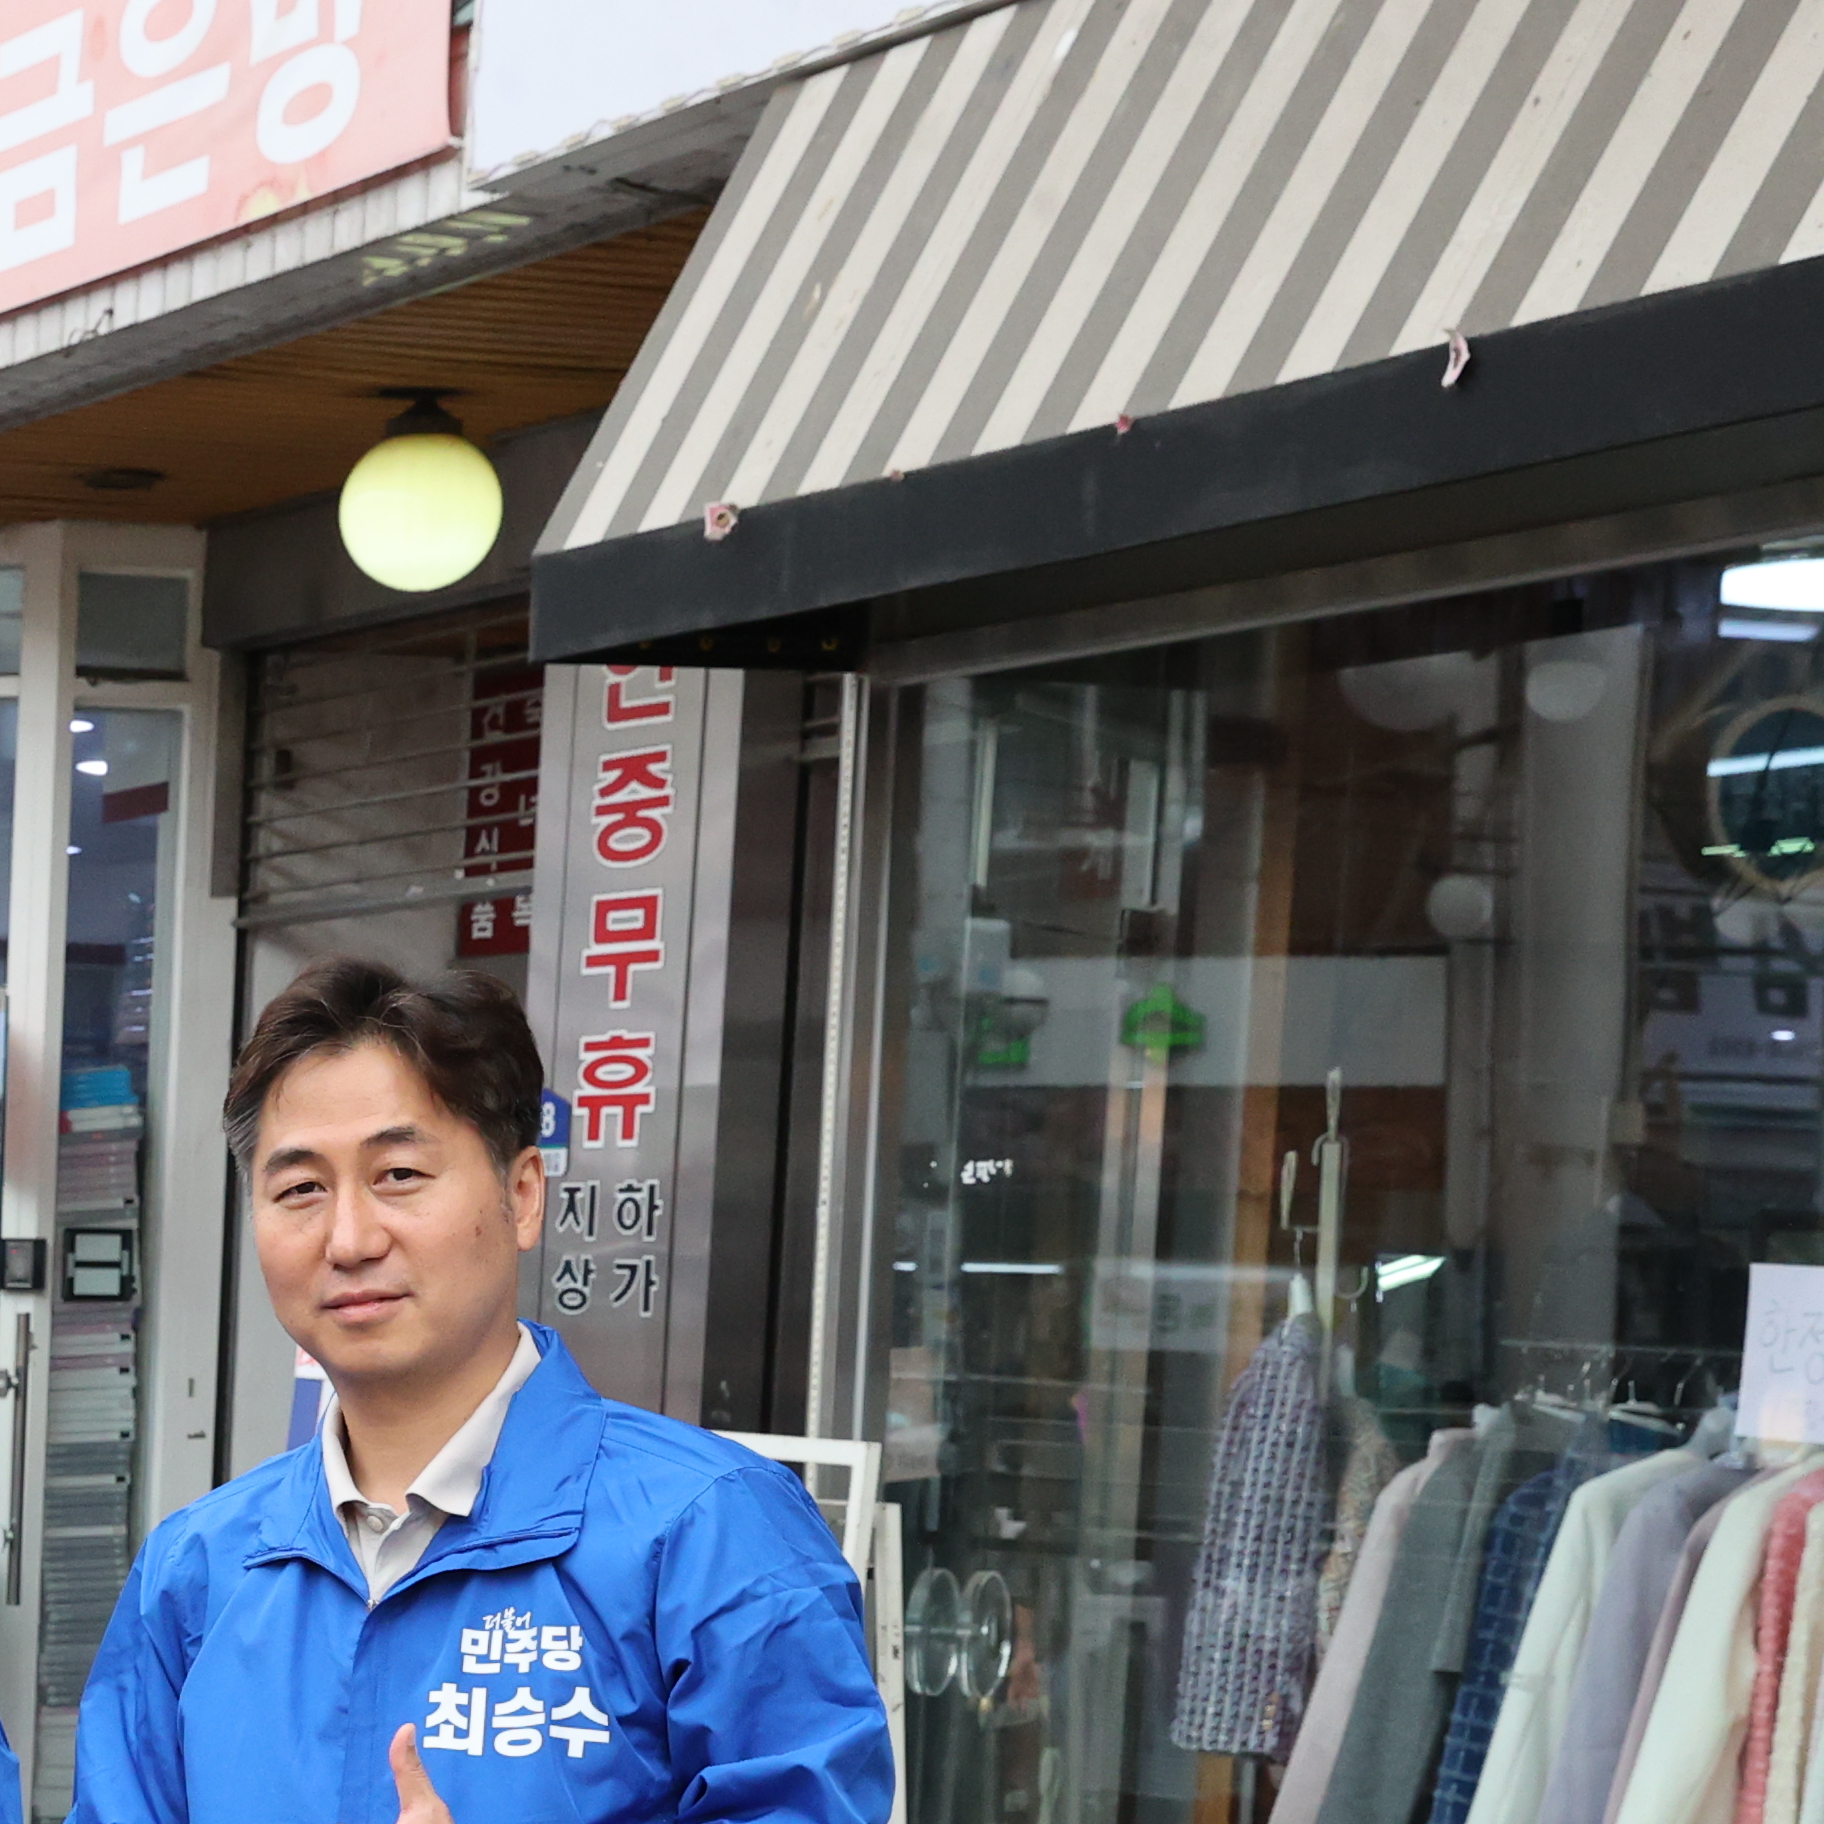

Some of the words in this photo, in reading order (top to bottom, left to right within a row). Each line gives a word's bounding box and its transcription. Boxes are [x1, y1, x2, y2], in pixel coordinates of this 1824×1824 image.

[555, 1180, 664, 1242] 지하
[552, 1254, 659, 1316] 상가
[459, 1624, 584, 1675] 민주당
[481, 1606, 533, 1632] 더불어
[422, 1682, 611, 1759] 최승수
